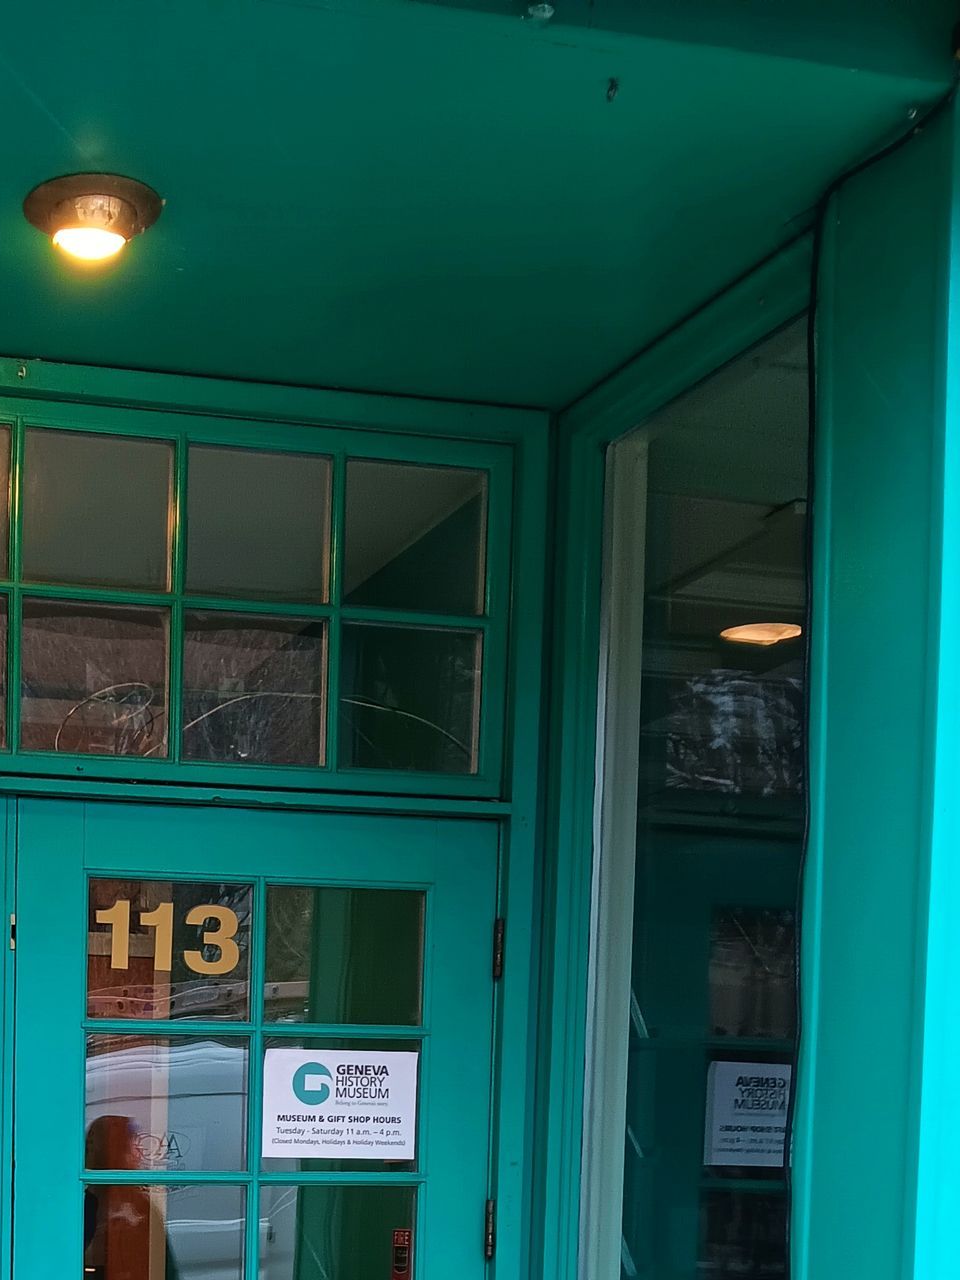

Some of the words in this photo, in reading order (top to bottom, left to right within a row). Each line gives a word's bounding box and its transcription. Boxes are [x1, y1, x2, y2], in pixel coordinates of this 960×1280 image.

[96, 900, 240, 975] 113
[336, 1064, 390, 1076] GENEVA
[335, 1076, 385, 1087] HISTORY
[335, 1087, 389, 1099] MUSEUM
[276, 1114, 316, 1122] MUSEUM
[327, 1115, 346, 1123] GIFT
[348, 1115, 371, 1124] SHOP
[372, 1116, 402, 1124] HOURS
[276, 1127, 306, 1136] Tuesday
[311, 1127, 344, 1137] Saturday
